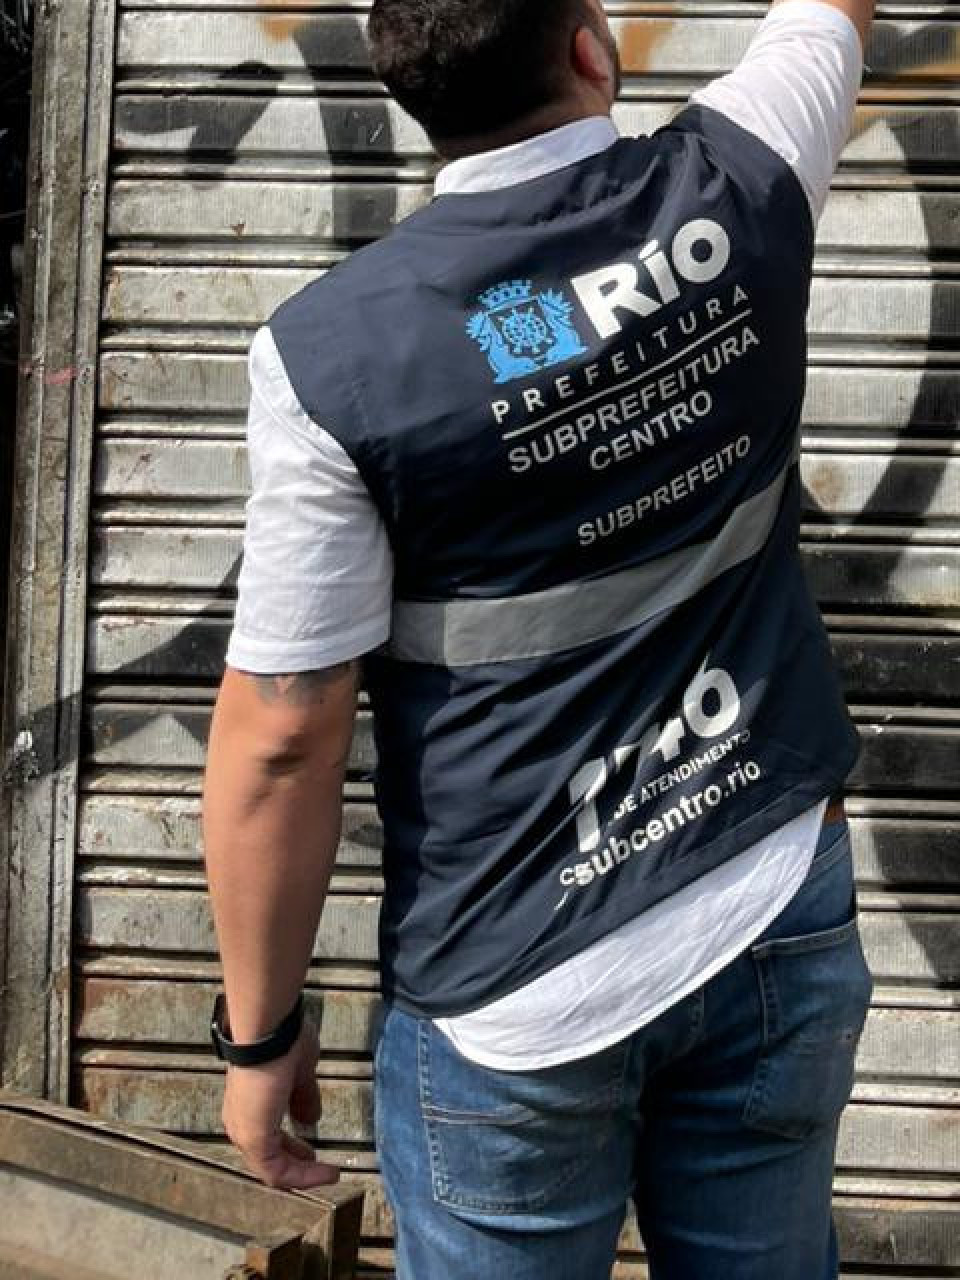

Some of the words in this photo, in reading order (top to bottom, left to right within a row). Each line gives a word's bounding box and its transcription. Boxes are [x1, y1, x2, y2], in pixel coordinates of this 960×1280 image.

[491, 285, 748, 424] PREFEITURA
[508, 325, 760, 473] SUBPREFEITURA
[577, 434, 751, 545] SUBPREFEITO
[589, 389, 713, 471] CENTRO
